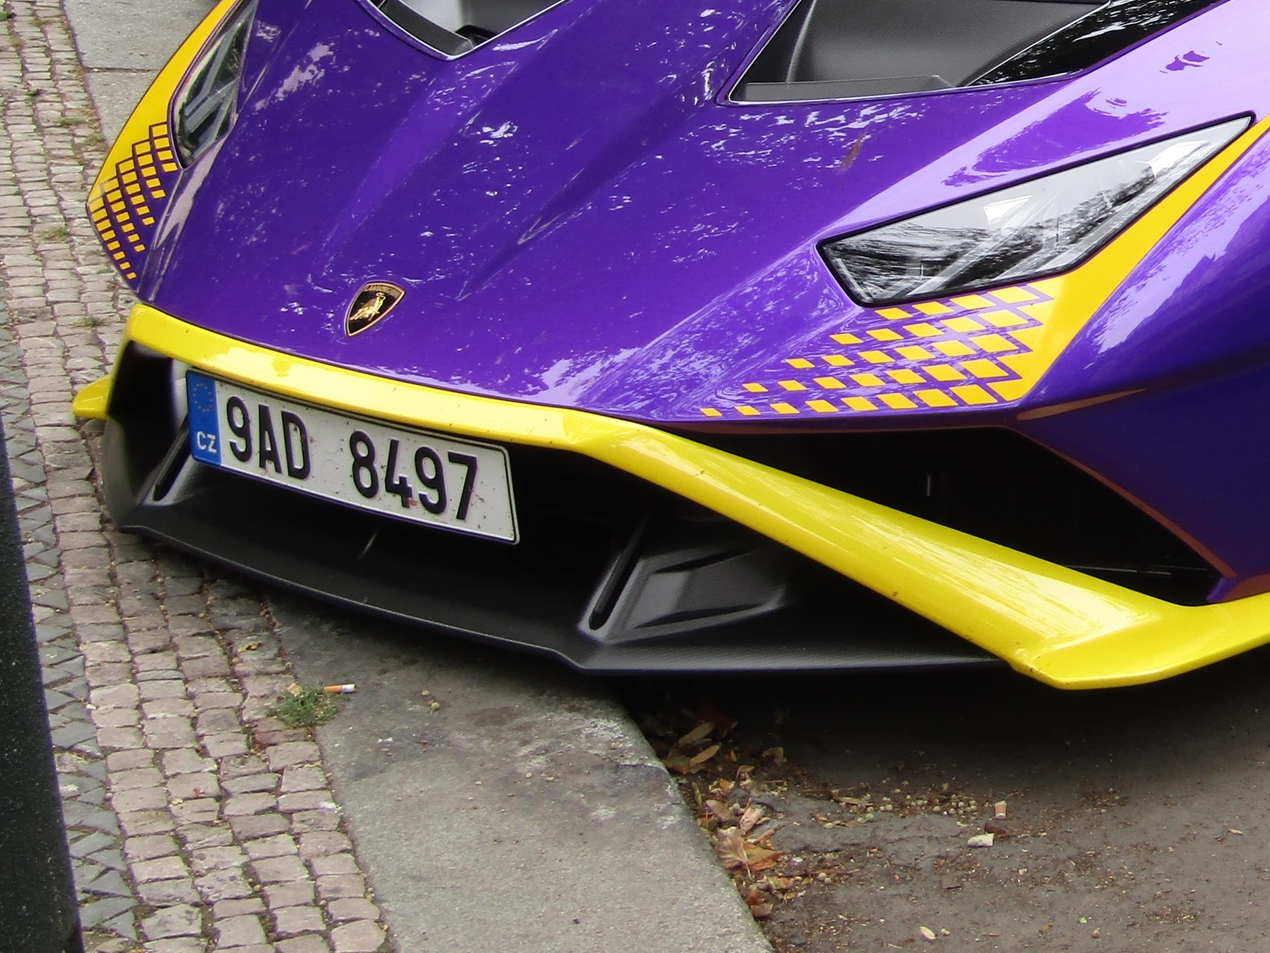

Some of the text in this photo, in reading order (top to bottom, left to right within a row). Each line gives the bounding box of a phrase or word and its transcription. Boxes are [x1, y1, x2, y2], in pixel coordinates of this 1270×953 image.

[196, 430, 217, 454] CZ
[226, 396, 477, 520] 9AD 8497
